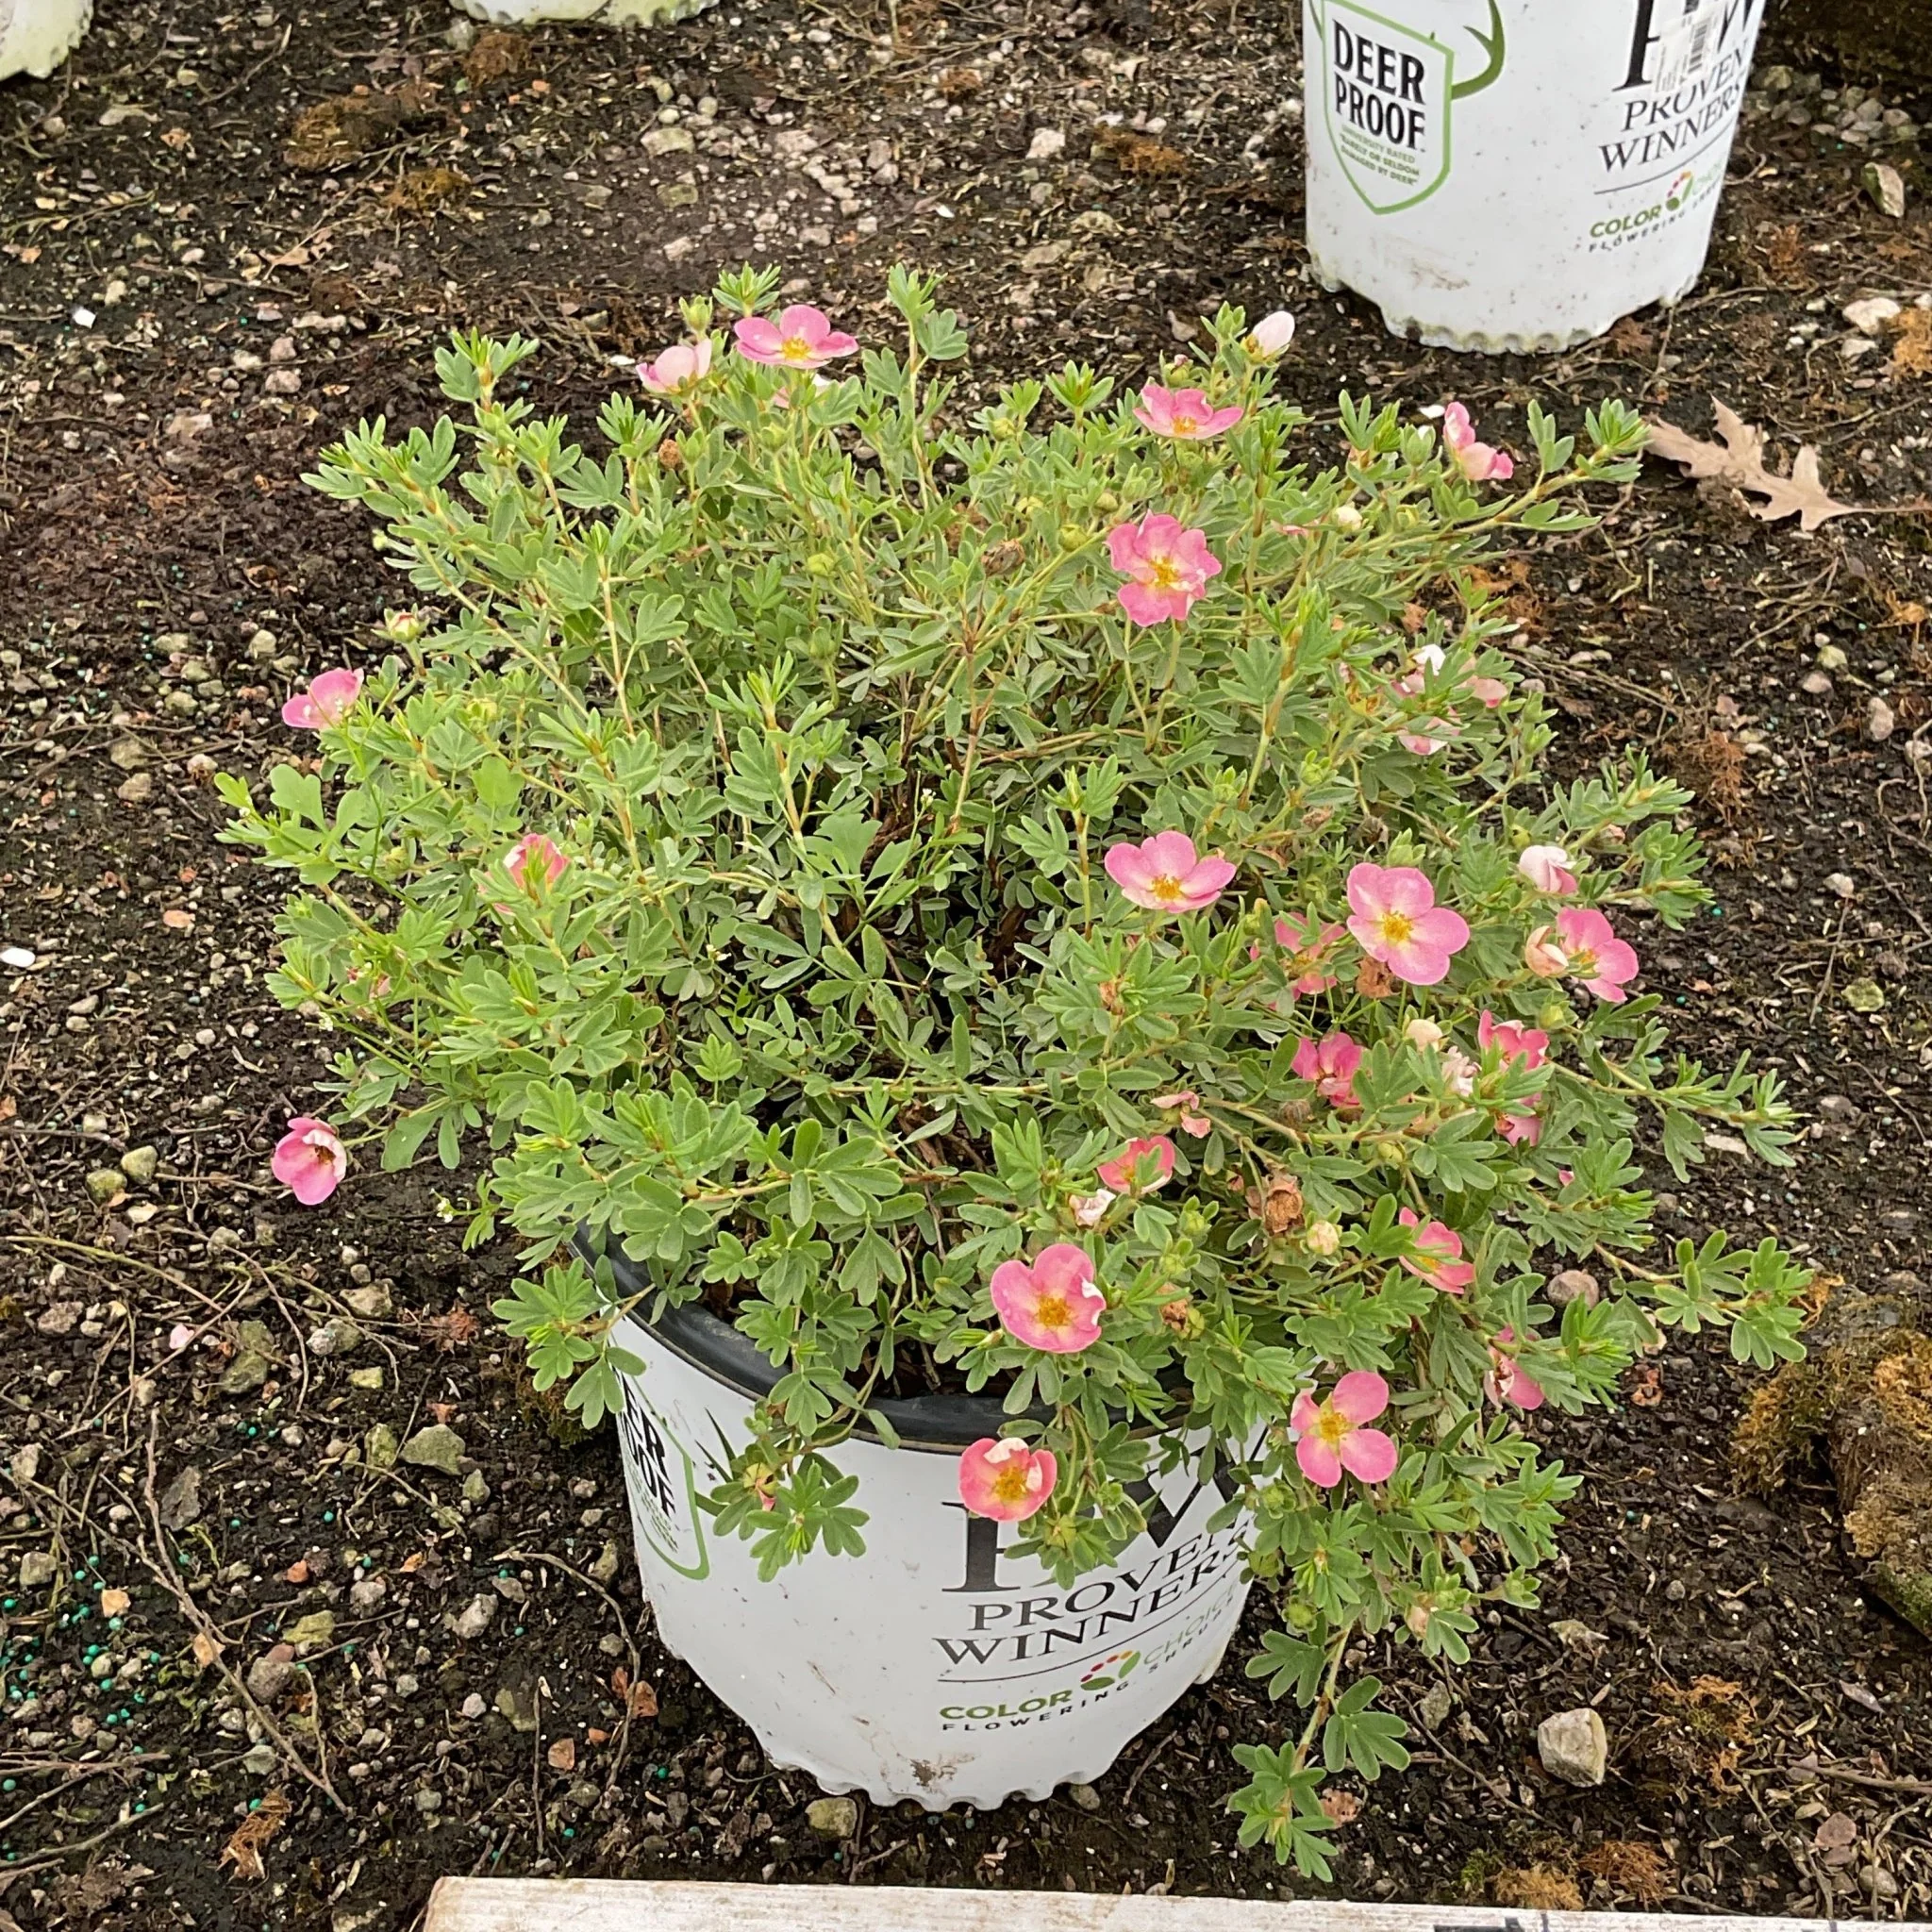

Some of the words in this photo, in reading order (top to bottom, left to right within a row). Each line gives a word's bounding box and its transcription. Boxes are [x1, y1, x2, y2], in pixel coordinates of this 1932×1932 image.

[1332, 18, 1425, 106] DEER
[1335, 72, 1425, 151] PROOF
[1589, 210, 1687, 254] FLOWERING
[1590, 204, 1662, 238] COLOR
[932, 1519, 1250, 1665] WINNERS
[940, 1690, 1073, 1720] COLOR
[941, 1681, 1129, 1731] FLOWERING
